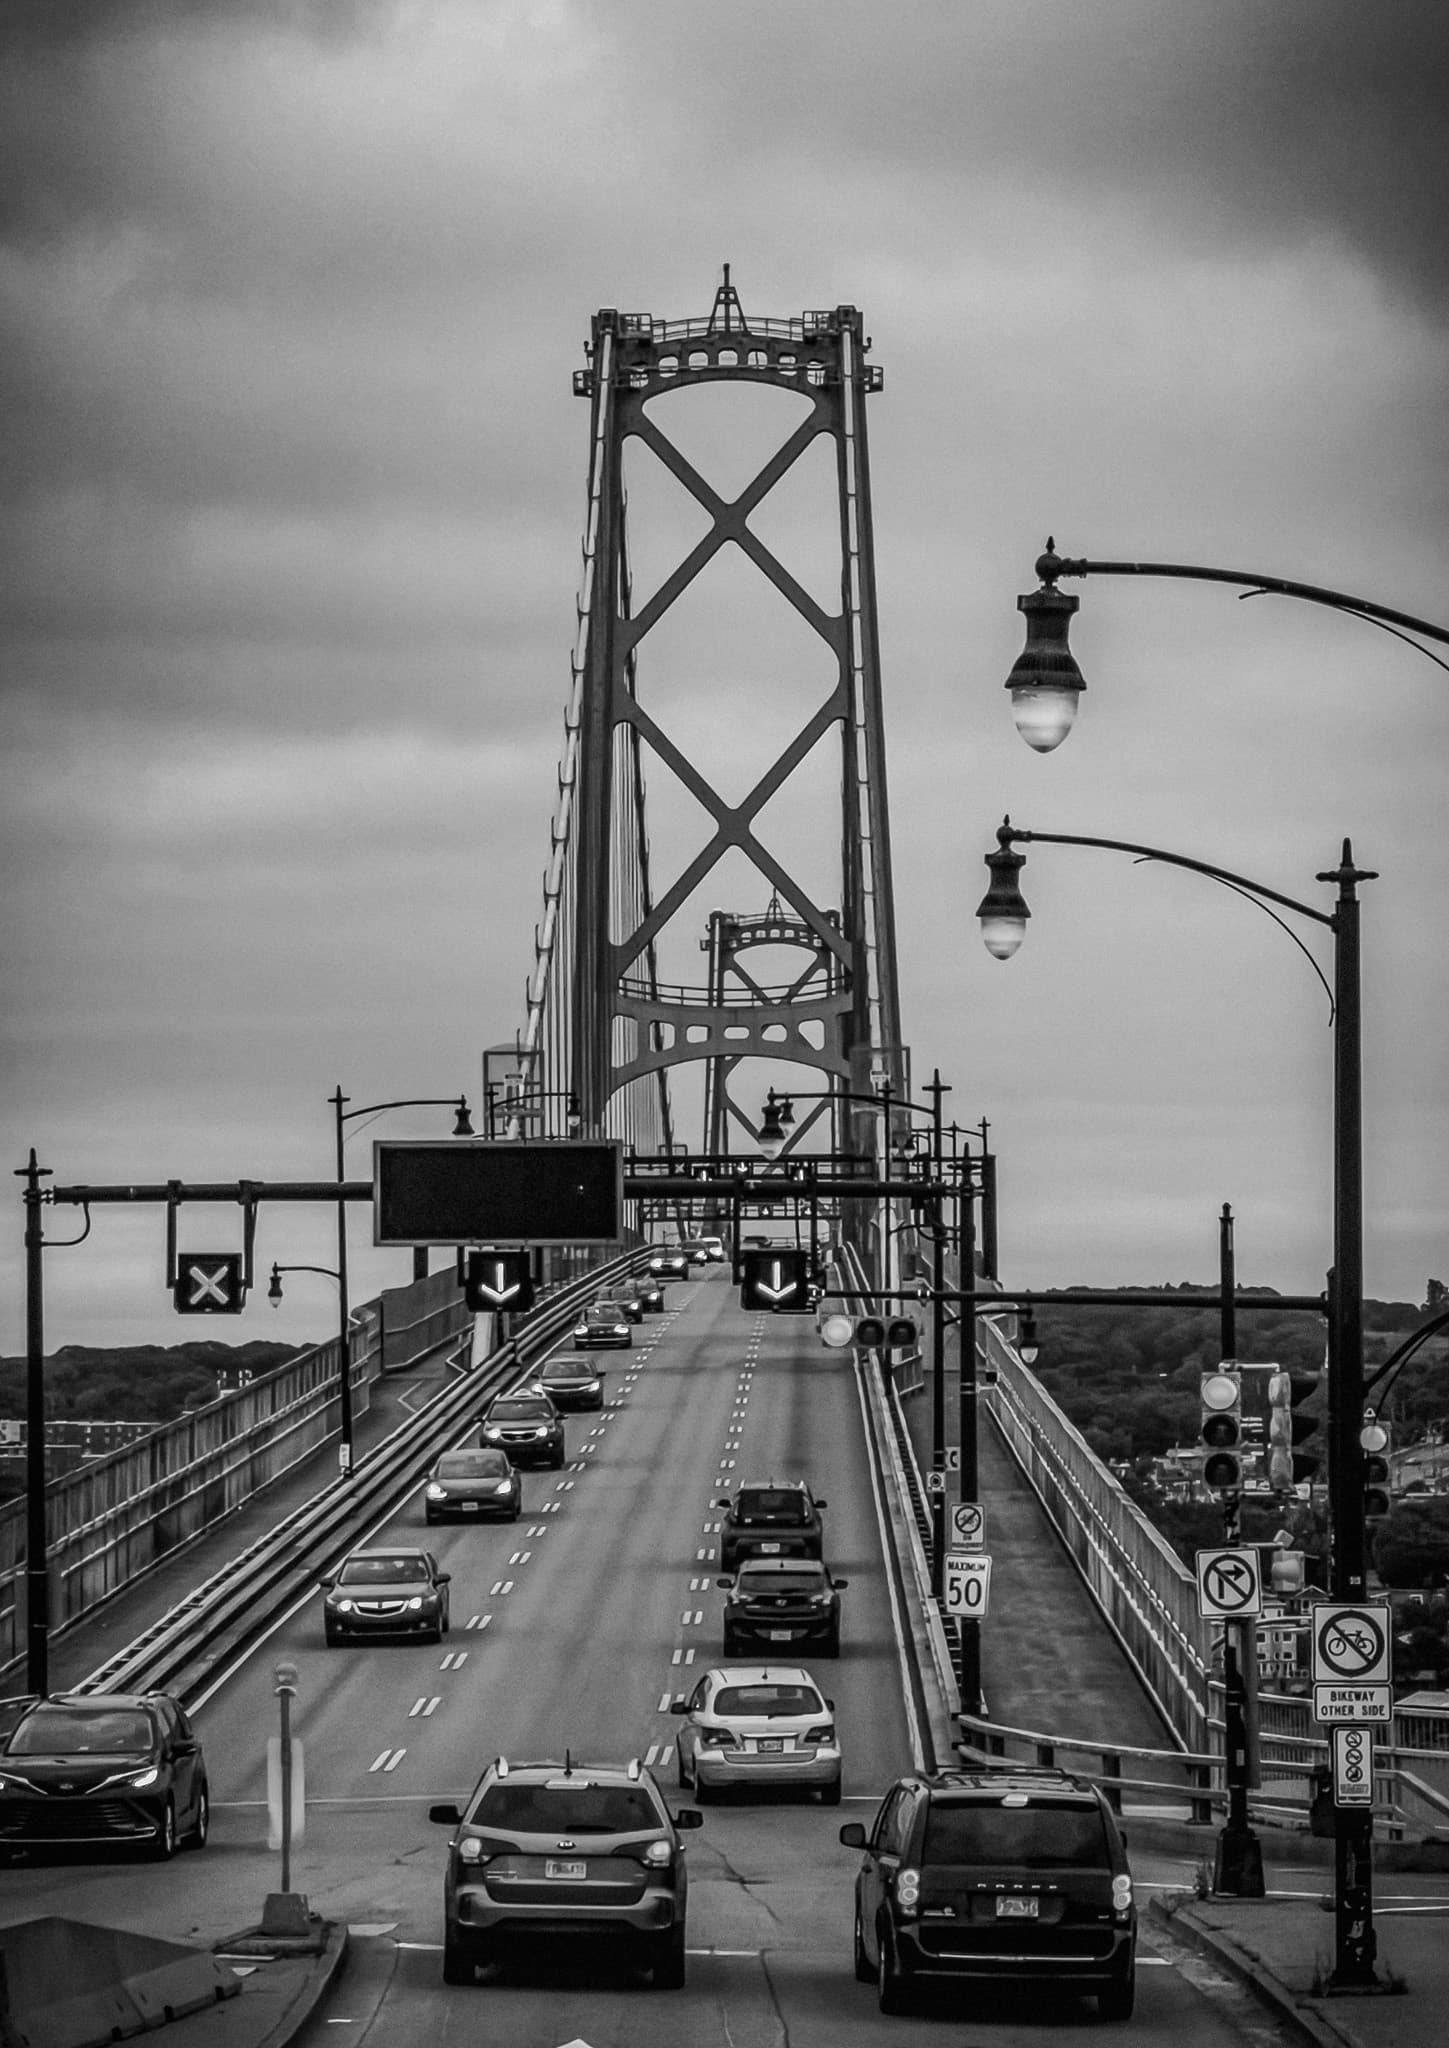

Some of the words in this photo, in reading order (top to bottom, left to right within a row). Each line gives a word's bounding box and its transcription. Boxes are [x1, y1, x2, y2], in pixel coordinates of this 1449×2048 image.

[948, 1561, 985, 1571] MAXIMUM
[949, 1577, 982, 1607] 50
[1330, 1691, 1375, 1702] BIKEWAY
[1321, 1705, 1355, 1716] OTHER
[1361, 1705, 1385, 1716] SIDE
